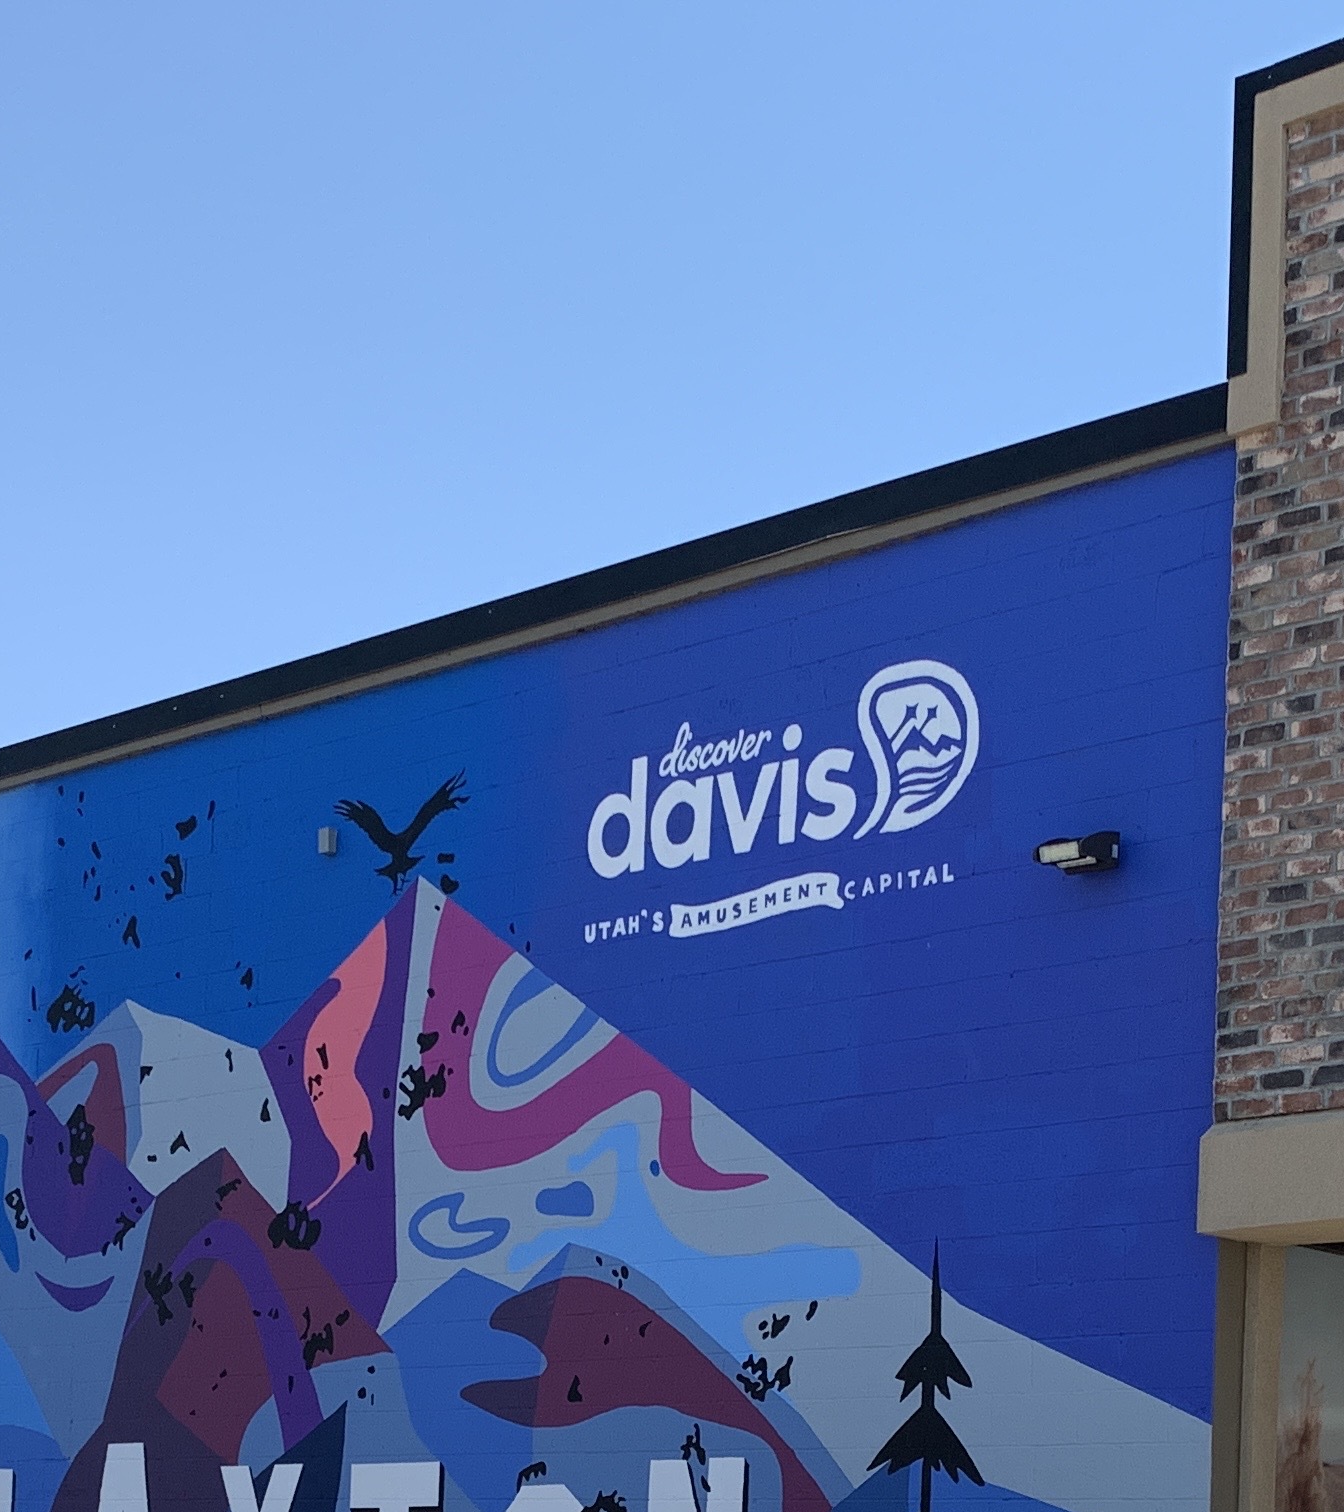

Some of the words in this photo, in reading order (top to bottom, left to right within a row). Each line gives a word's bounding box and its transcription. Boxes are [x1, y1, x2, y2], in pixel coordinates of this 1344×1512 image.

[659, 722, 771, 777] discover
[587, 724, 855, 879] davis
[584, 908, 664, 944] UTAH'S
[680, 881, 830, 930] AMUSEMENT
[844, 862, 955, 901] CAPITAL
